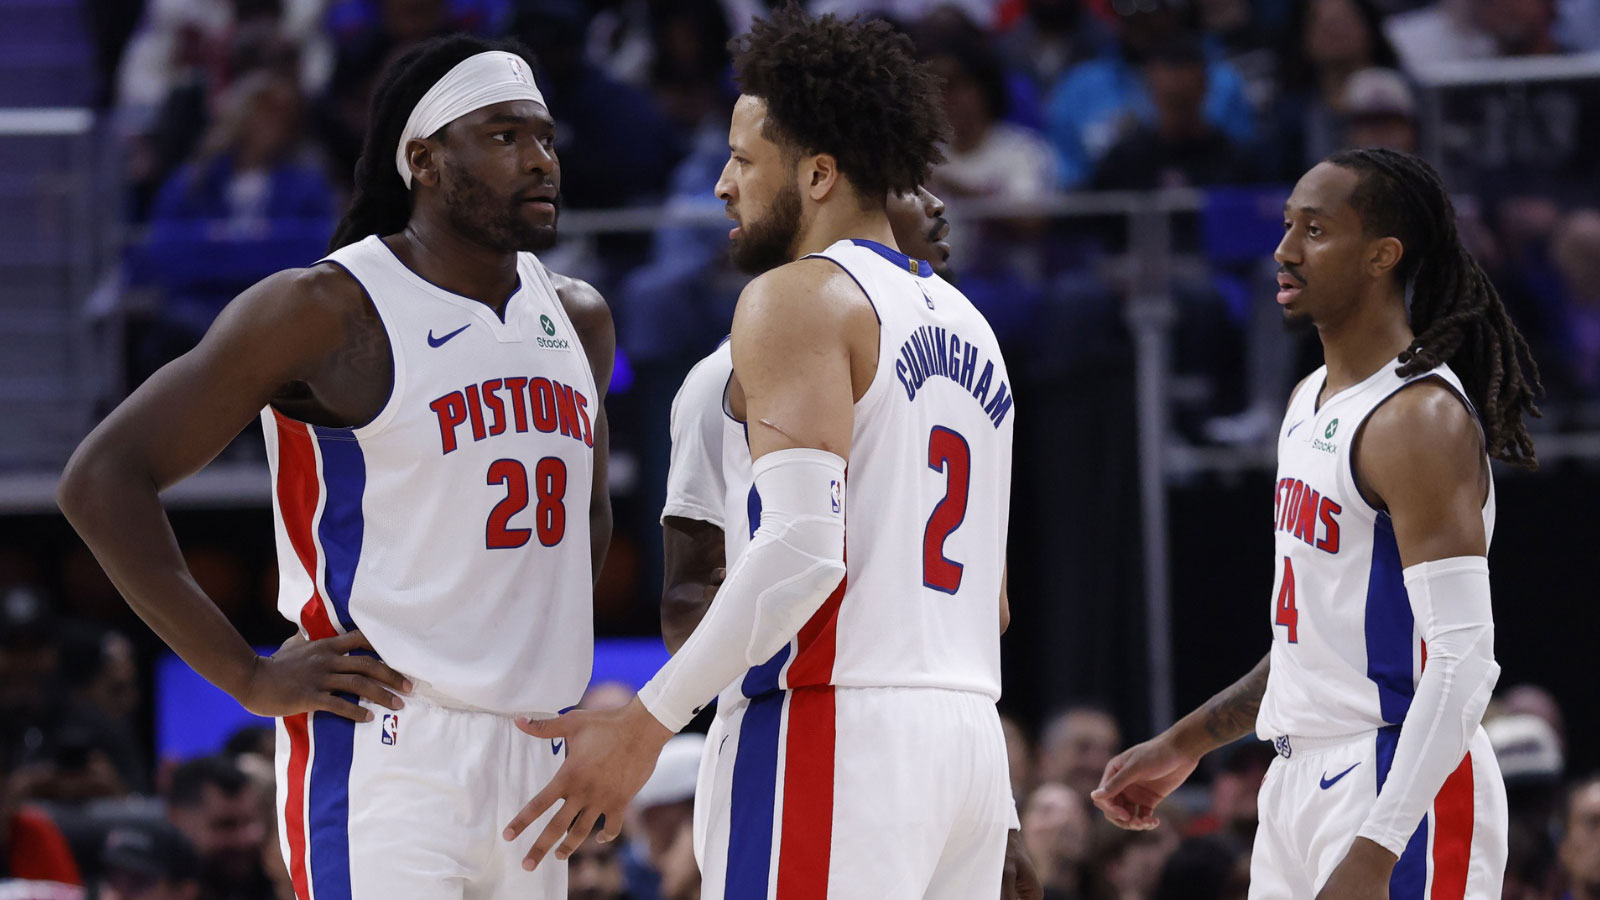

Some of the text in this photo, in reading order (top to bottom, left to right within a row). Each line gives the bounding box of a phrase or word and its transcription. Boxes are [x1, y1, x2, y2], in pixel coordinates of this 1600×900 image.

[429, 376, 594, 455] PISTONS
[896, 325, 1012, 430] CUNNINGHAM
[485, 456, 567, 549] 28
[922, 425, 971, 595] 2
[1274, 477, 1342, 554] STONS
